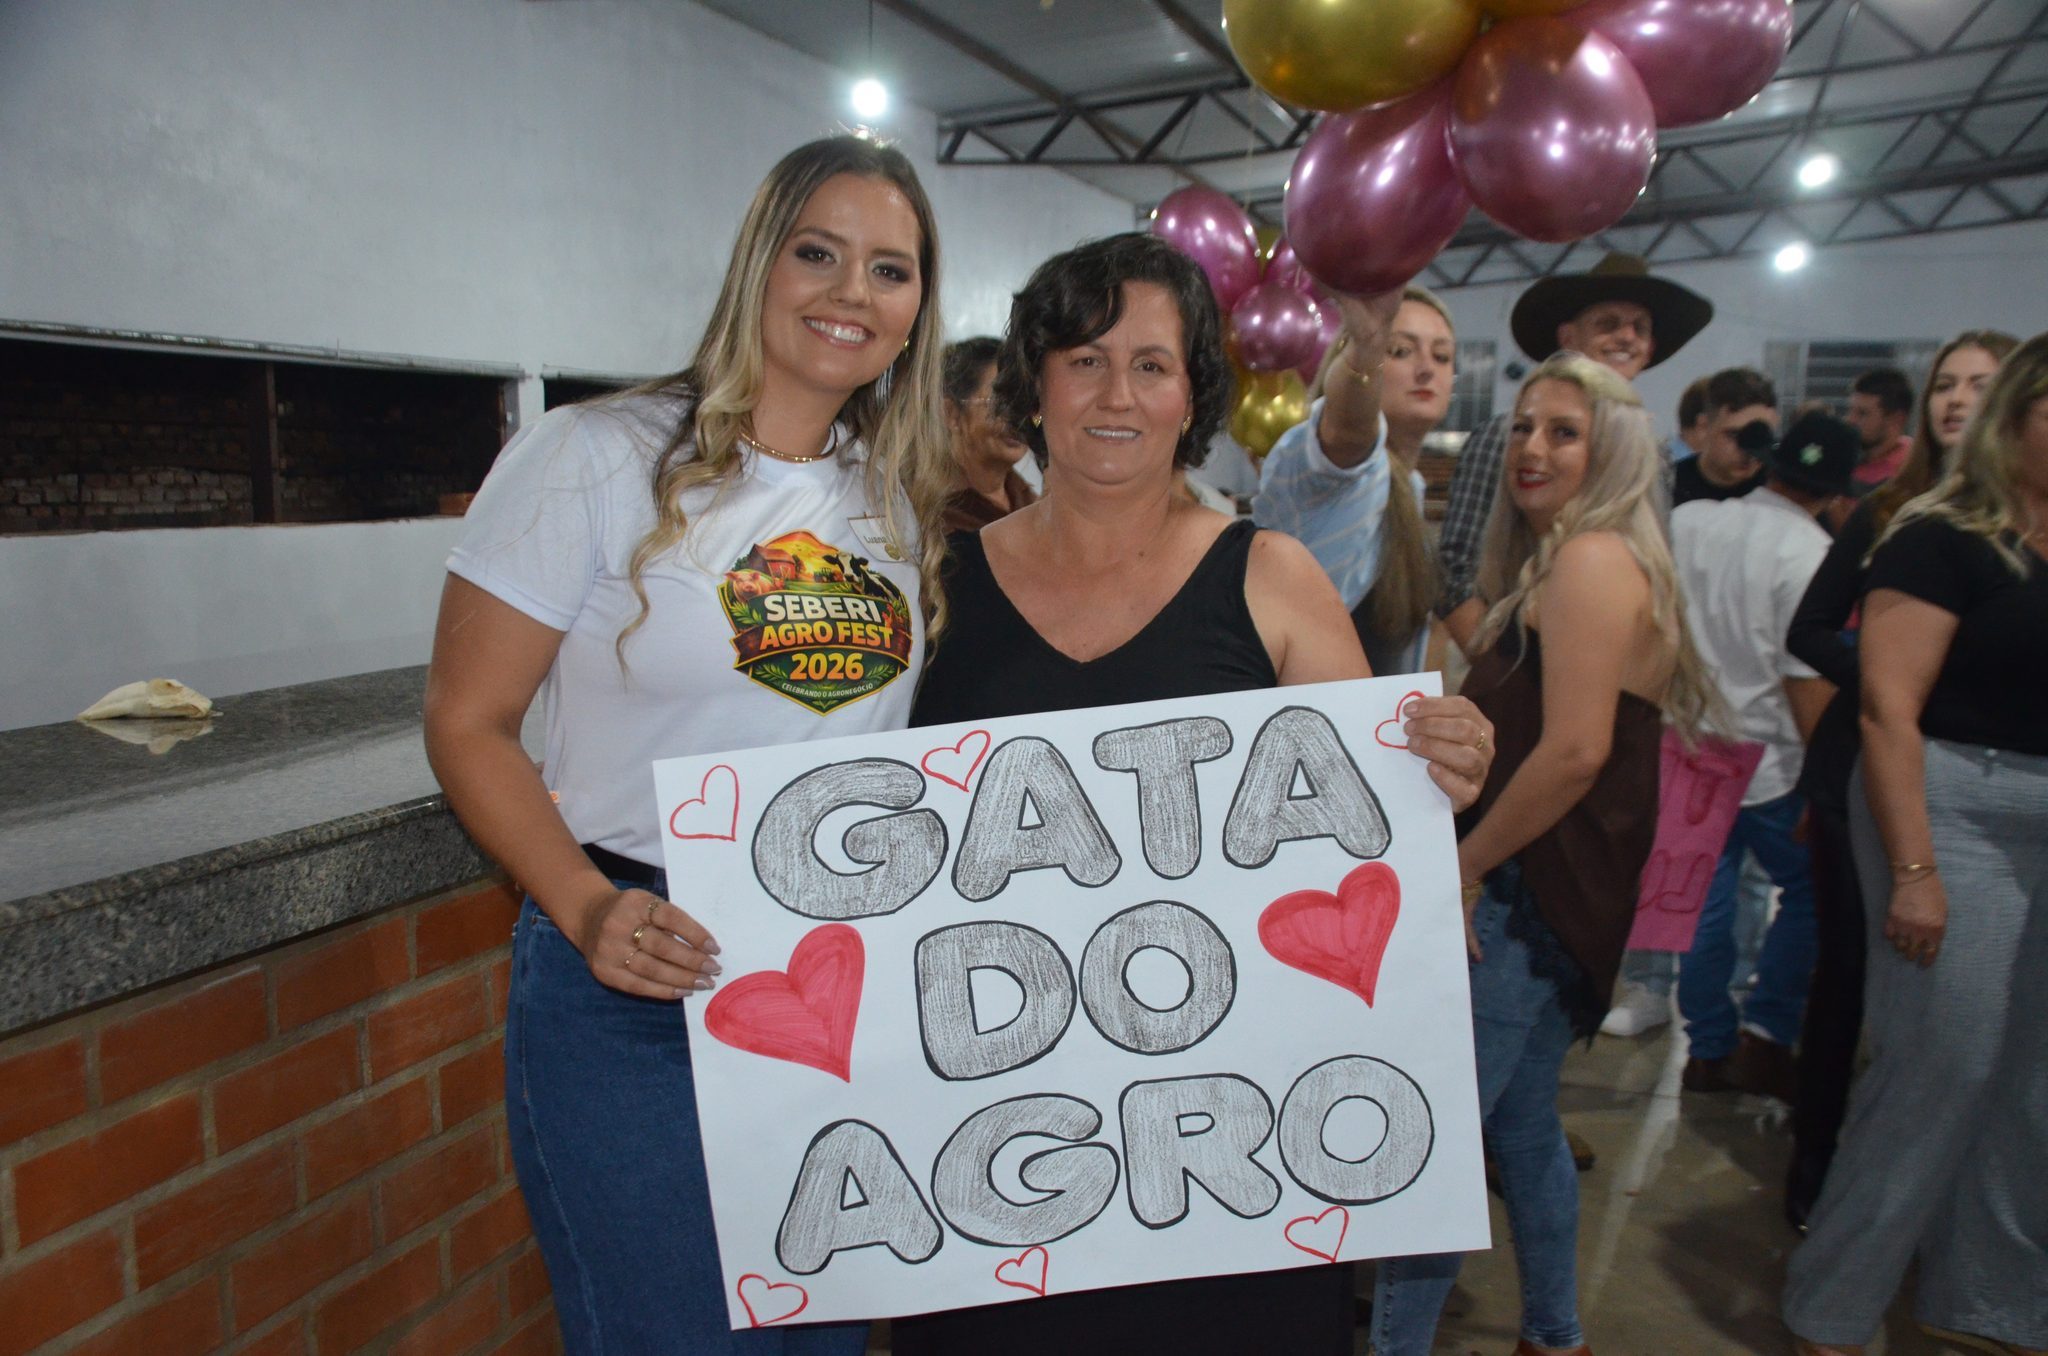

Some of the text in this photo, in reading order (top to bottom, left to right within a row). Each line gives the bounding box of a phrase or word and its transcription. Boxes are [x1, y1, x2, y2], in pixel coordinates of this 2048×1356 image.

[764, 595, 882, 623] SEBERI
[759, 621, 893, 650] AGRO FEST
[790, 653, 864, 681] 2026
[781, 682, 822, 697] CELEBRANDO
[828, 682, 874, 697] AGRONEGÓCIO
[751, 706, 1391, 921] GATA
[915, 900, 1236, 1081] DO
[775, 1054, 1435, 1275] AGRO
